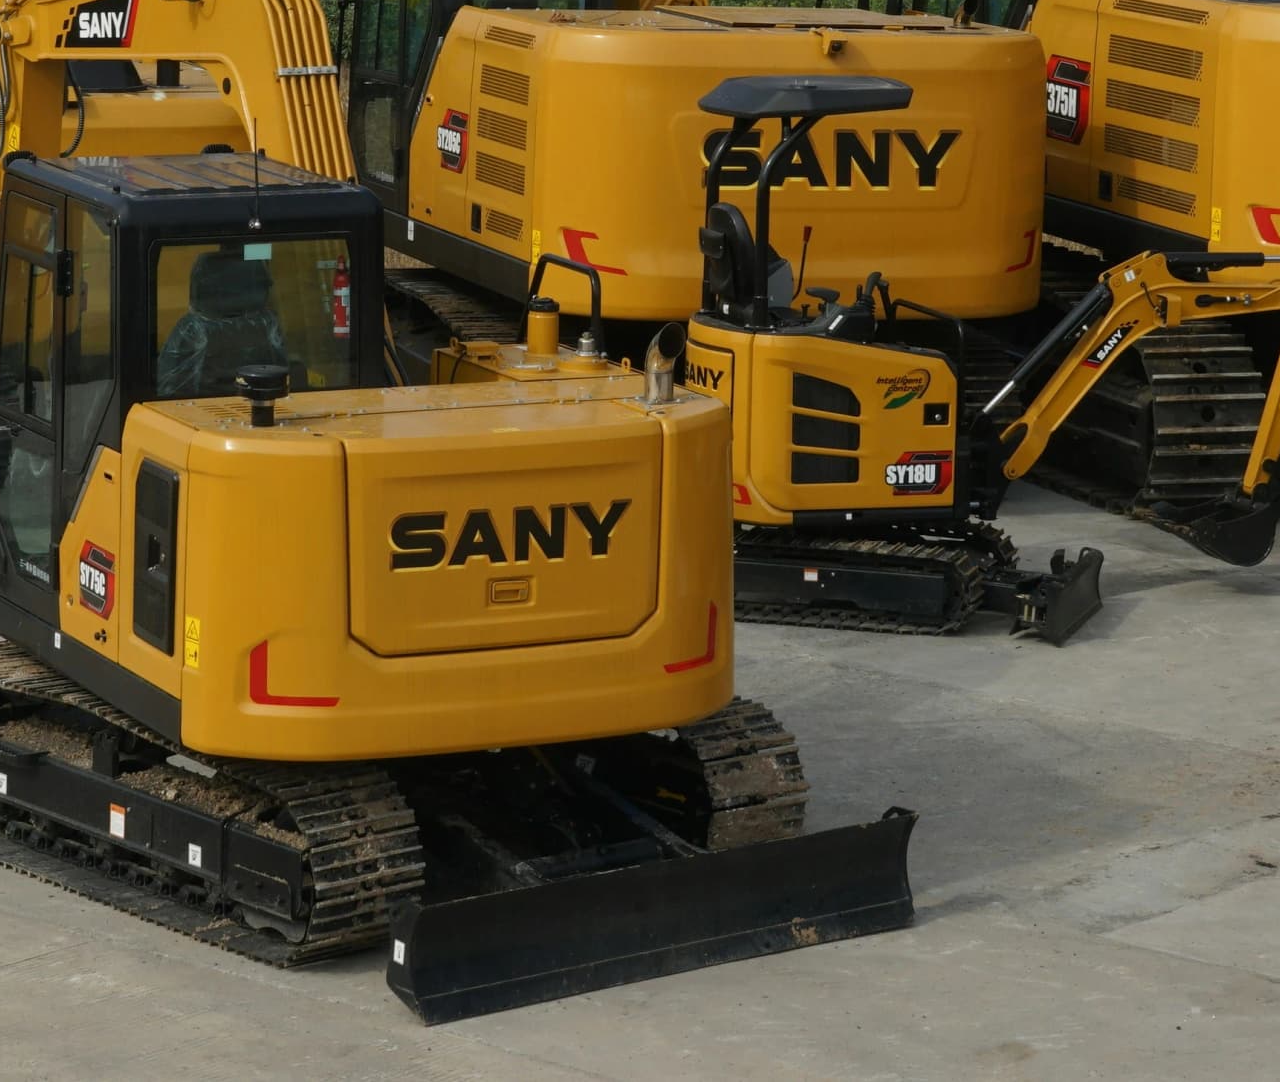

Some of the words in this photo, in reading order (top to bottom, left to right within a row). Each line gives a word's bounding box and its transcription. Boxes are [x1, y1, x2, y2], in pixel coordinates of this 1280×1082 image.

[79, 11, 124, 39] SANY
[1046, 81, 1078, 119] 375H
[437, 126, 461, 155] SY205C
[702, 129, 963, 191] SANY
[1097, 328, 1122, 361] SANY
[886, 464, 936, 485] SY18U
[388, 498, 632, 573] SANY
[80, 561, 106, 597] SY75C
